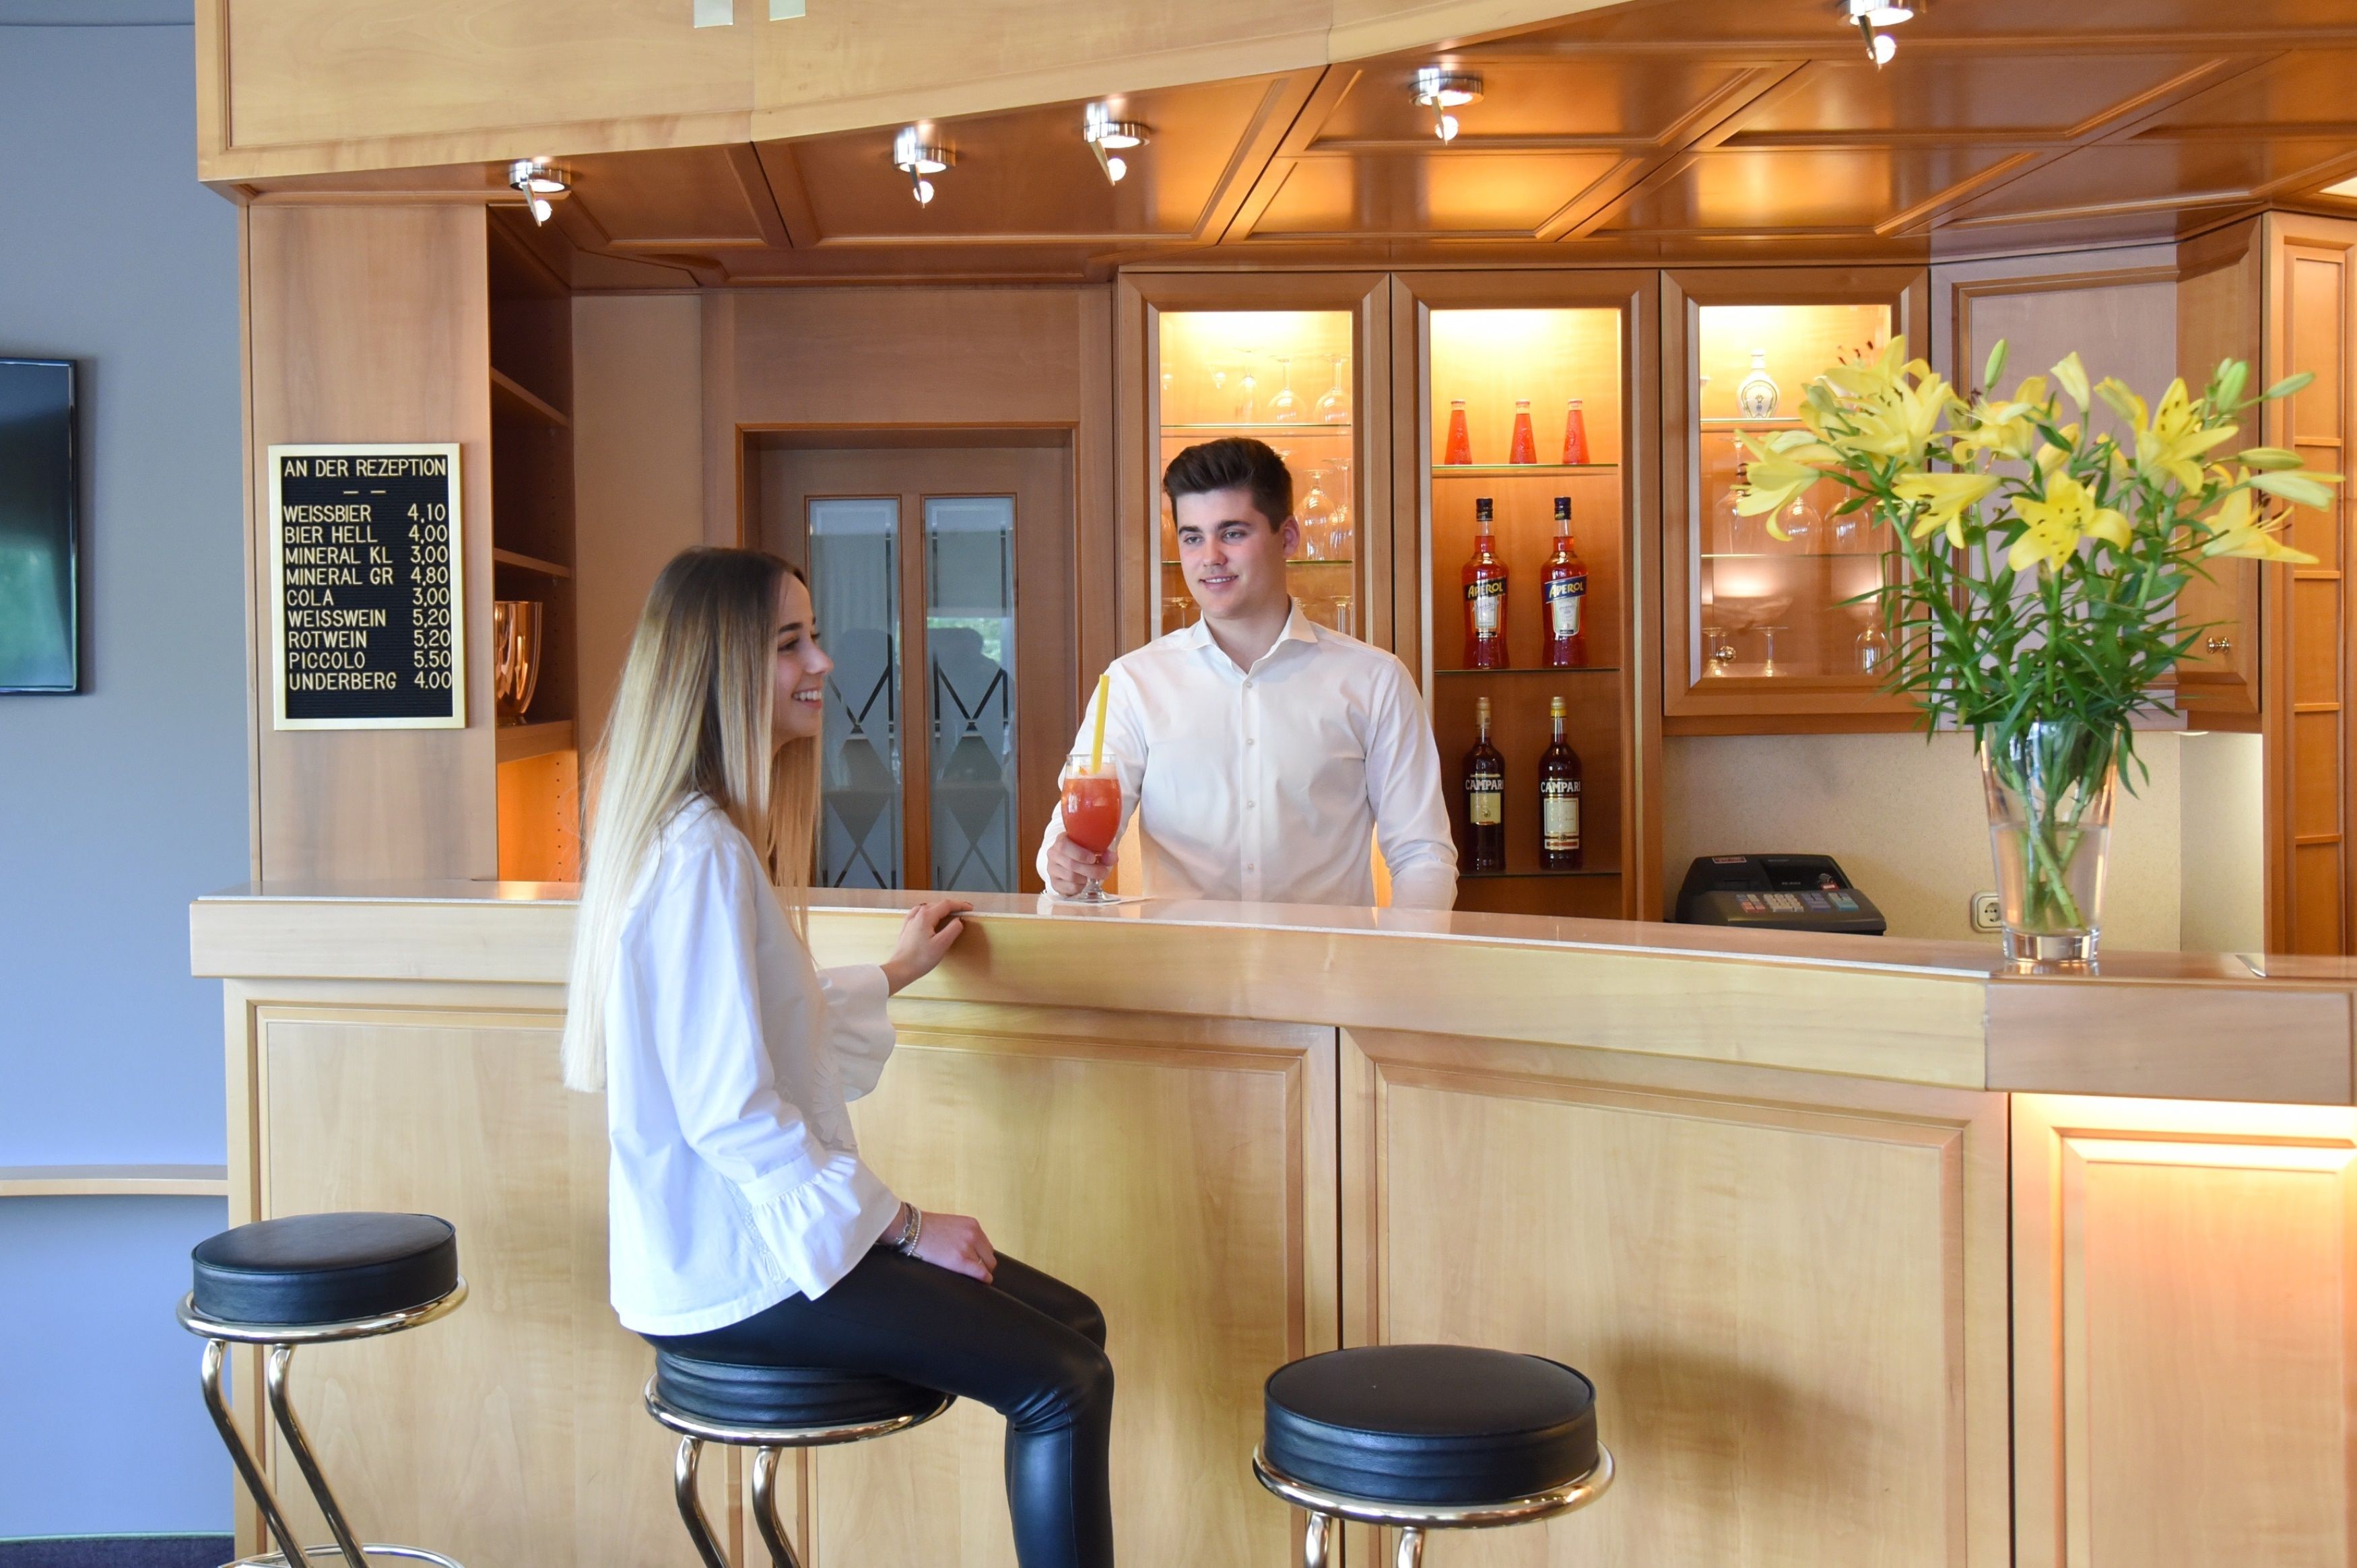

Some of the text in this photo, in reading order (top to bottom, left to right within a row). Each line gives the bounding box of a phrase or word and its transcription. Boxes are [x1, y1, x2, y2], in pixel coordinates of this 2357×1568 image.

[284, 458, 446, 477] AN DER REZEPTION
[283, 504, 372, 523] WEISSBIER
[284, 525, 323, 544] BIER
[331, 524, 378, 544] HELL
[285, 547, 362, 565] MINERAL
[370, 546, 393, 565] KL
[286, 567, 363, 586] MINERAL
[370, 567, 393, 585] GR
[286, 588, 334, 607] COLA
[1468, 582, 1503, 599] APEROL
[1550, 582, 1584, 598] APEROL
[288, 609, 386, 627] WEISSWEIN
[288, 630, 367, 649] ROTWEIN
[289, 650, 452, 670] PICCOLO 5.50
[289, 671, 453, 691] UNDERBERG 4.00
[1465, 779, 1504, 790] CAMPARI
[1541, 781, 1581, 793] CAMPARI
